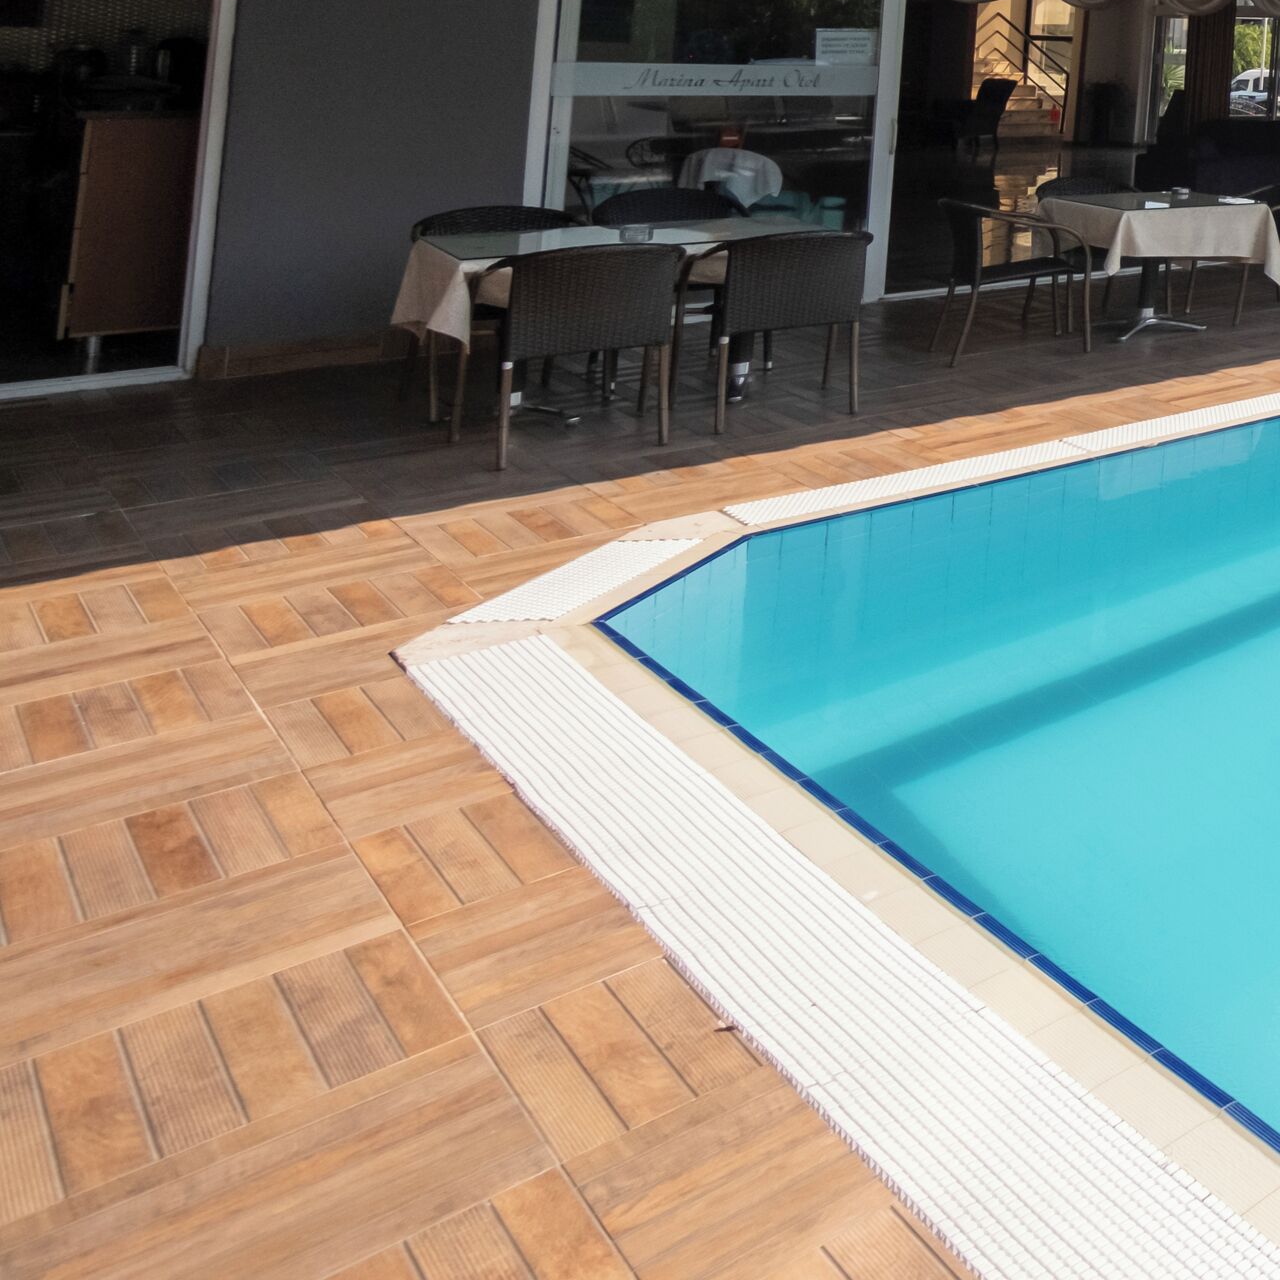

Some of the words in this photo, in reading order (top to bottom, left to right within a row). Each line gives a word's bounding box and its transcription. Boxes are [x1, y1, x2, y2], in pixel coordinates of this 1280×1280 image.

[623, 68, 705, 90] Marina
[713, 68, 775, 91] Apart
[783, 69, 821, 88] Otel
